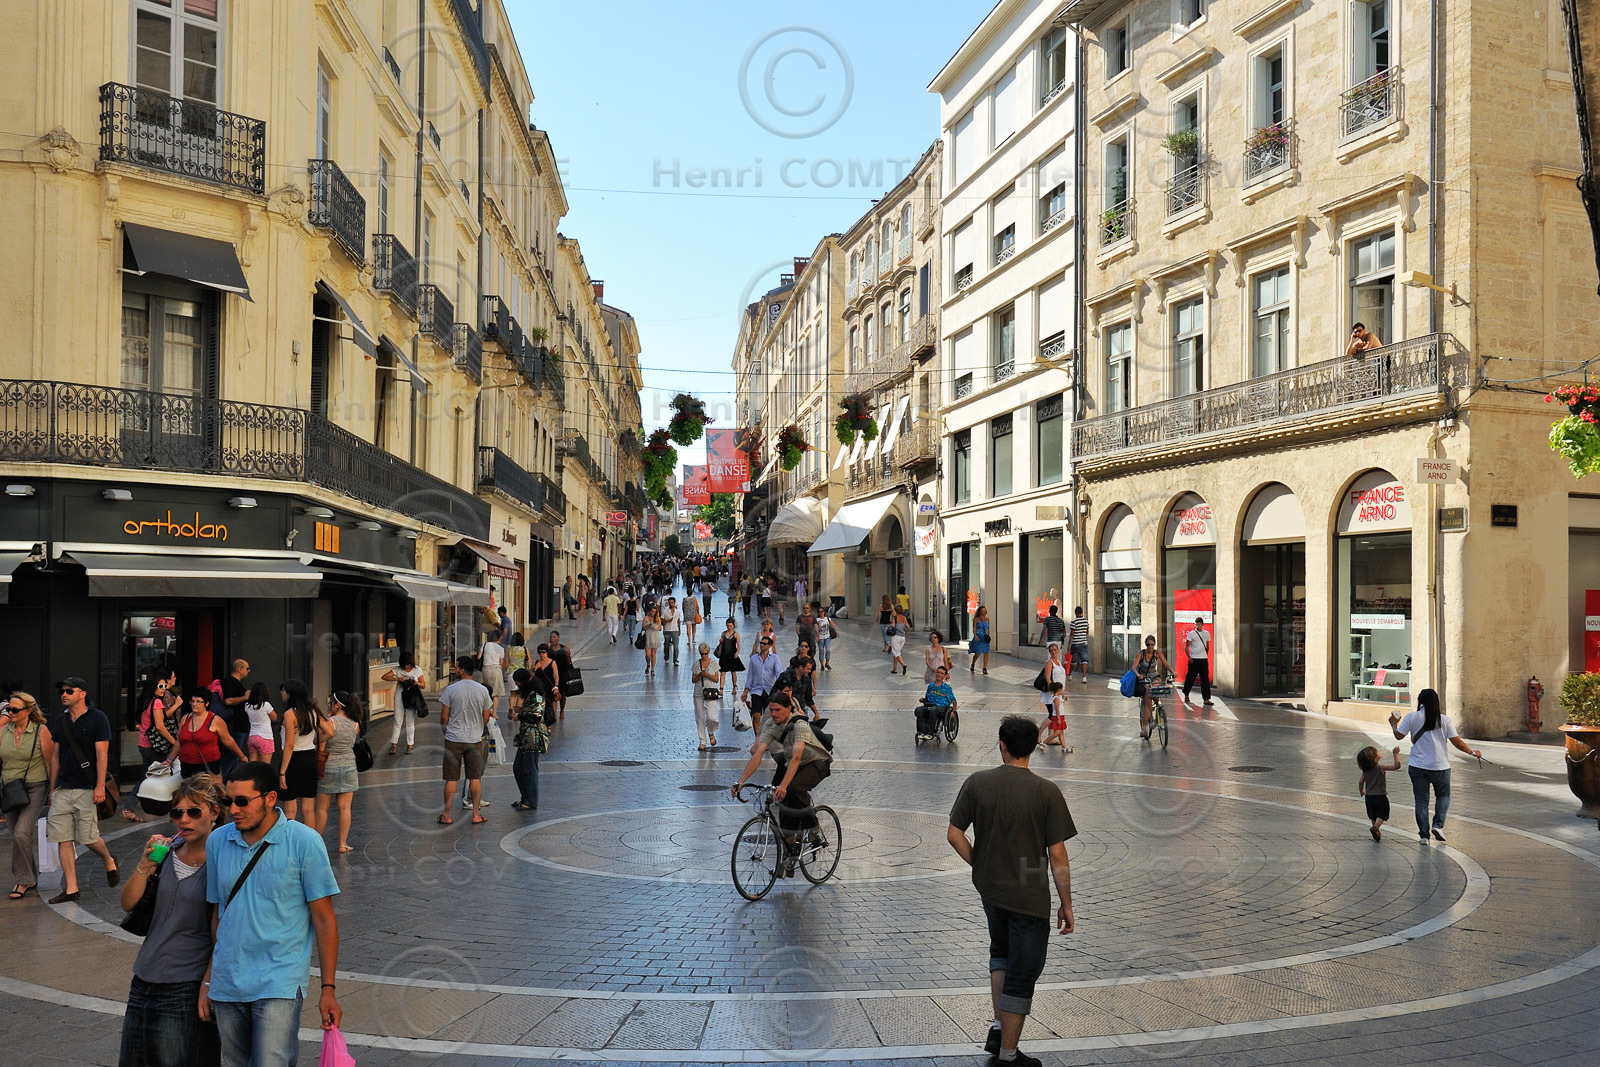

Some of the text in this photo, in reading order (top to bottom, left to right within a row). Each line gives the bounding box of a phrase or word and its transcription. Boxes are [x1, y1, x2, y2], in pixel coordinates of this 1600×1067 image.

[709, 464, 747, 476] DANSE
[1422, 462, 1452, 471] FRANCE
[1427, 472, 1448, 480] ARNO
[1350, 485, 1404, 505] FRANCE
[1173, 506, 1211, 521] FRANCE
[1358, 504, 1395, 521] ARNO
[123, 509, 228, 542] ortholan
[1179, 520, 1206, 536] ARNO
